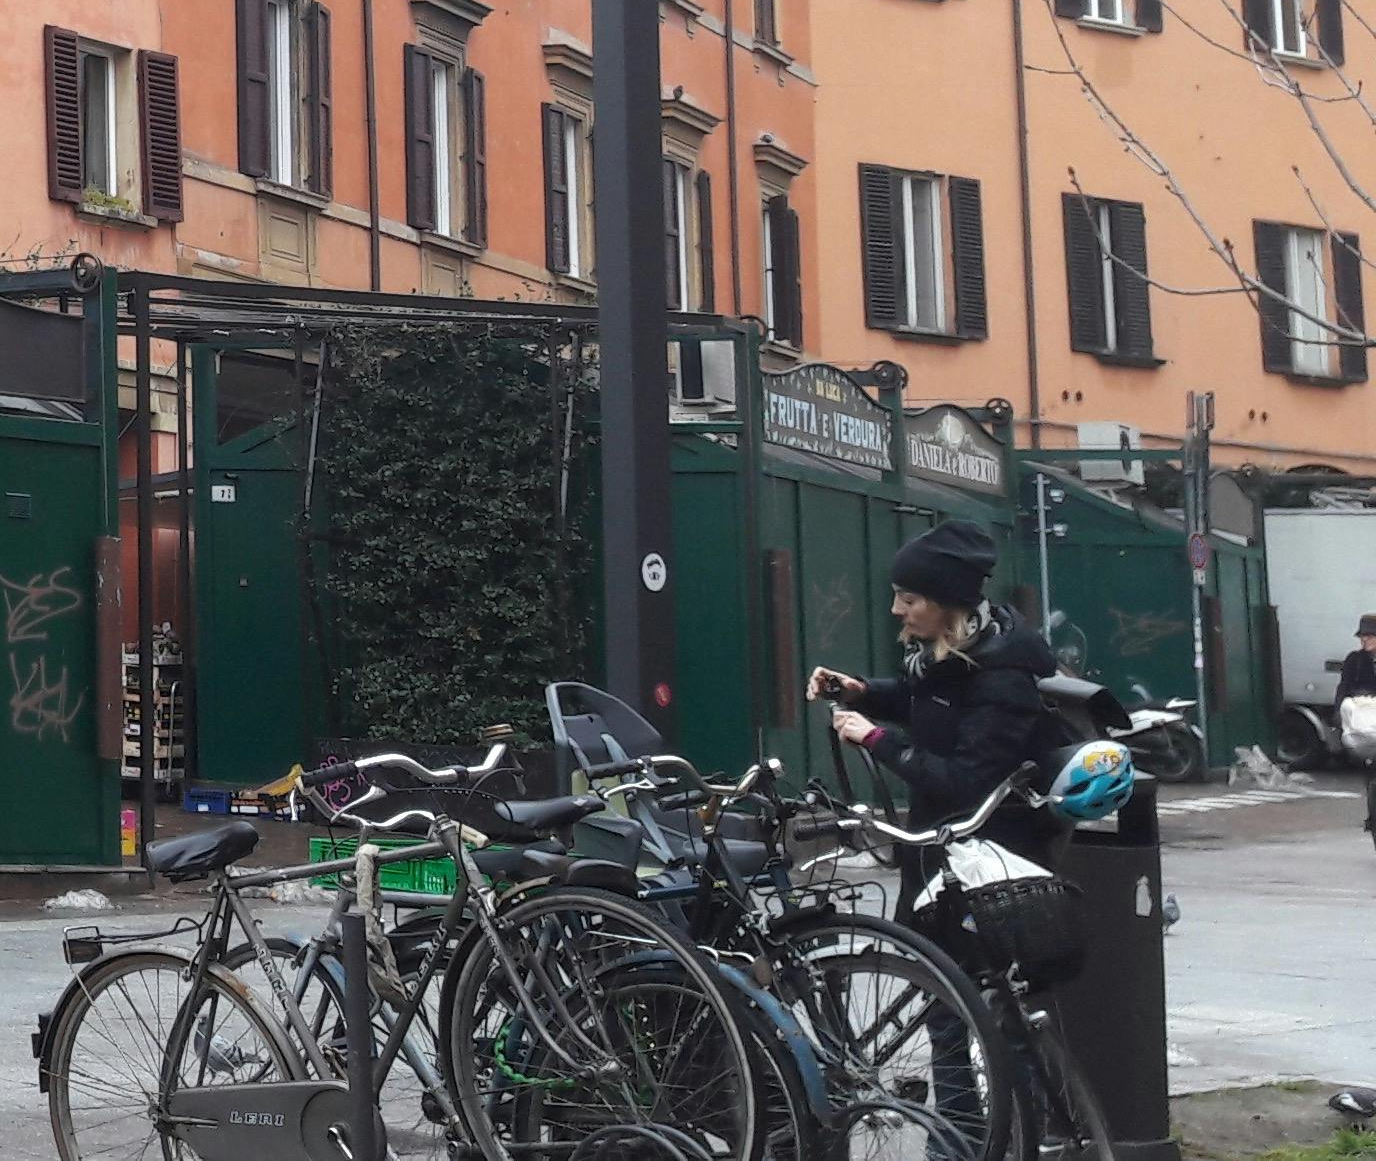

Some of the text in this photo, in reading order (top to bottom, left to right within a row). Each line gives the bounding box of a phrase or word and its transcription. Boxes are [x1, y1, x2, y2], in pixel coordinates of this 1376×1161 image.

[768, 391, 883, 453] FRUTTA E VERDURA
[910, 438, 952, 475] DANIELA
[958, 451, 1000, 486] ROBERTO
